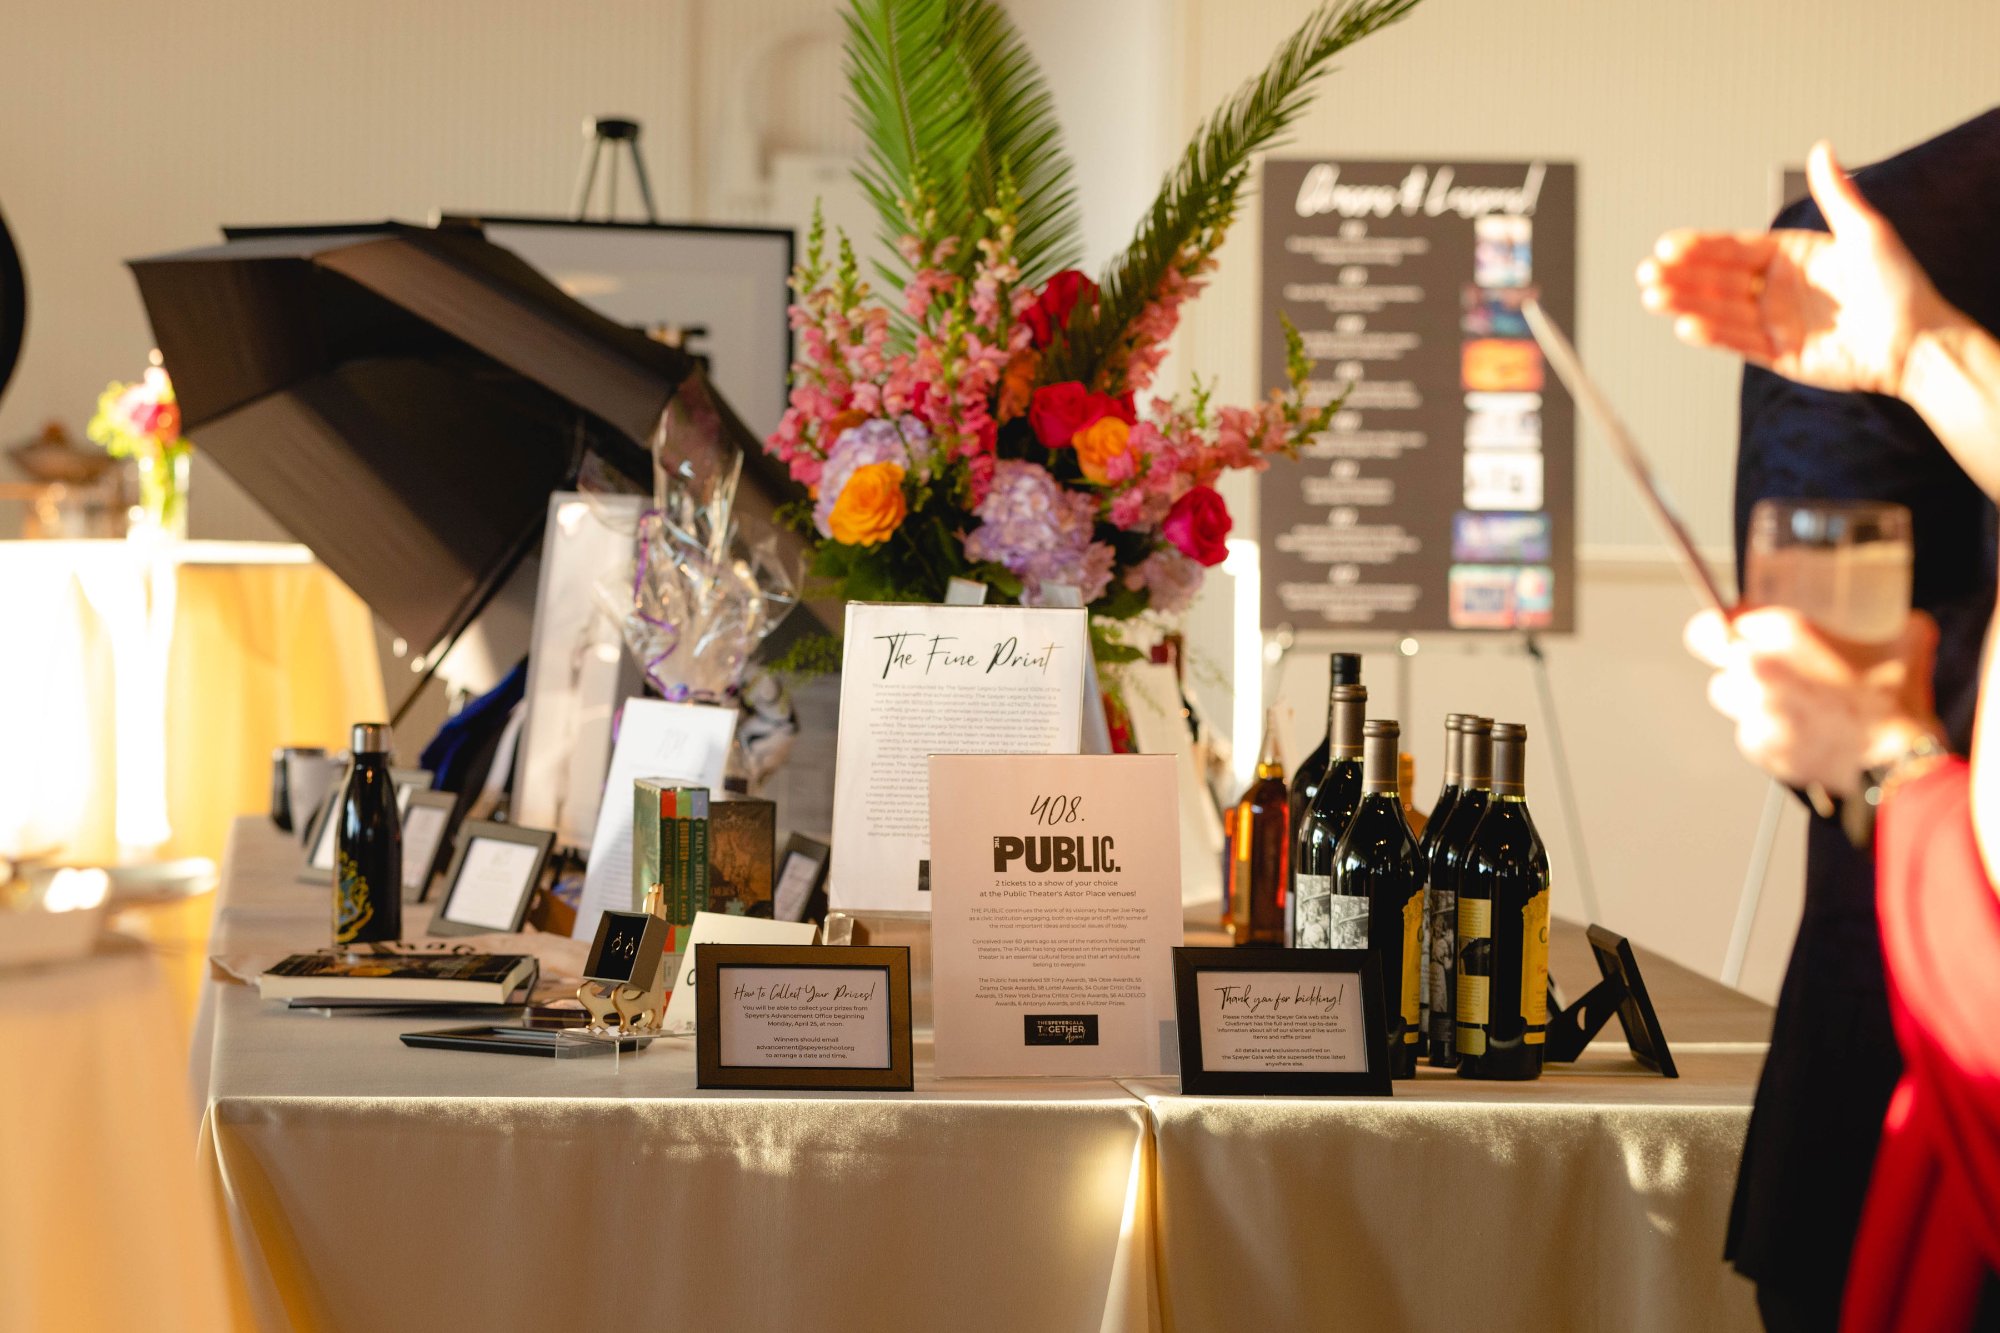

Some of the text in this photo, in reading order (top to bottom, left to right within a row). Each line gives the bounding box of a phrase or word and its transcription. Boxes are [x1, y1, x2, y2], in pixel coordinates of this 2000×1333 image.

[874, 631, 1064, 679] The Fine Print
[1030, 794, 1085, 825] 408.
[1075, 881, 1092, 889] your
[734, 984, 755, 1001] How
[769, 984, 804, 1000] Collect
[805, 984, 829, 1002] Your
[833, 982, 876, 1001] Prizes!
[1214, 984, 1344, 1013] Thank you for bidding!
